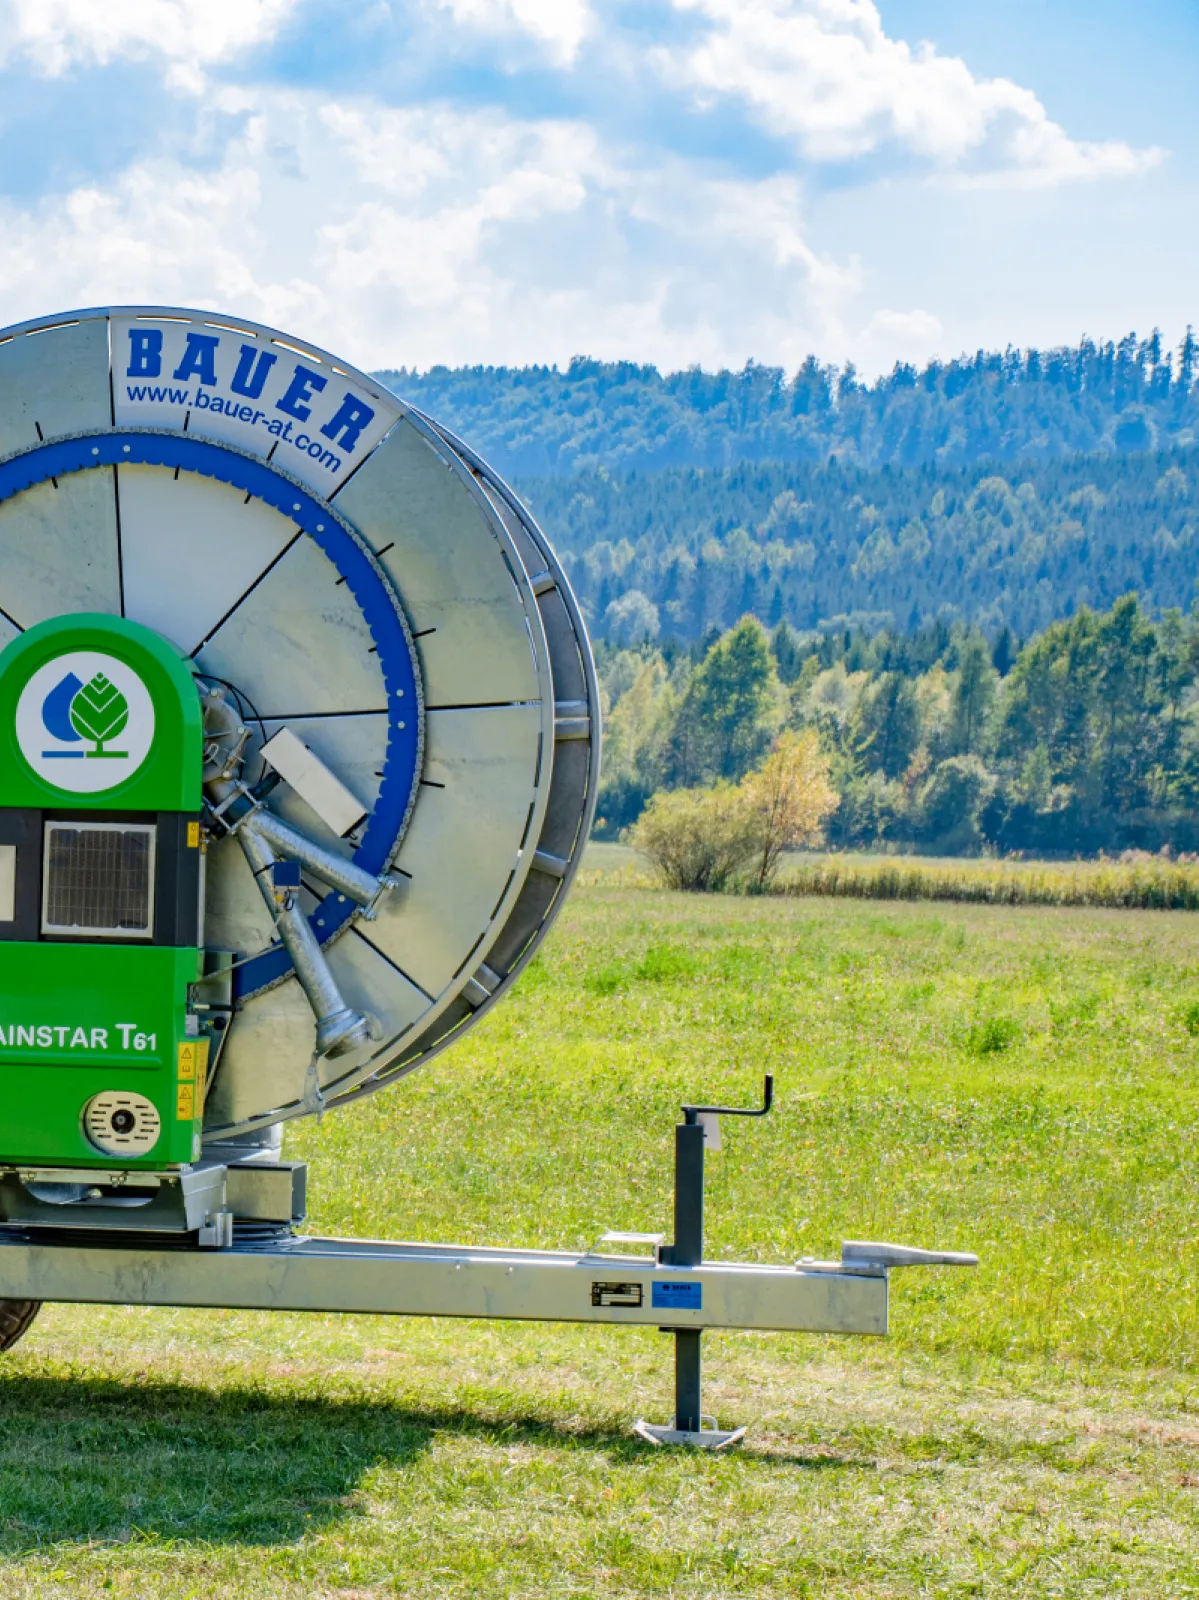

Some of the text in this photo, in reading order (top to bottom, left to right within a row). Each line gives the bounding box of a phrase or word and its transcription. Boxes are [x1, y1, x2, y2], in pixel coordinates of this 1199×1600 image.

[126, 328, 375, 454] BAUER
[126, 385, 342, 474] www.bauer-at.com
[115, 1023, 157, 1051] T61
